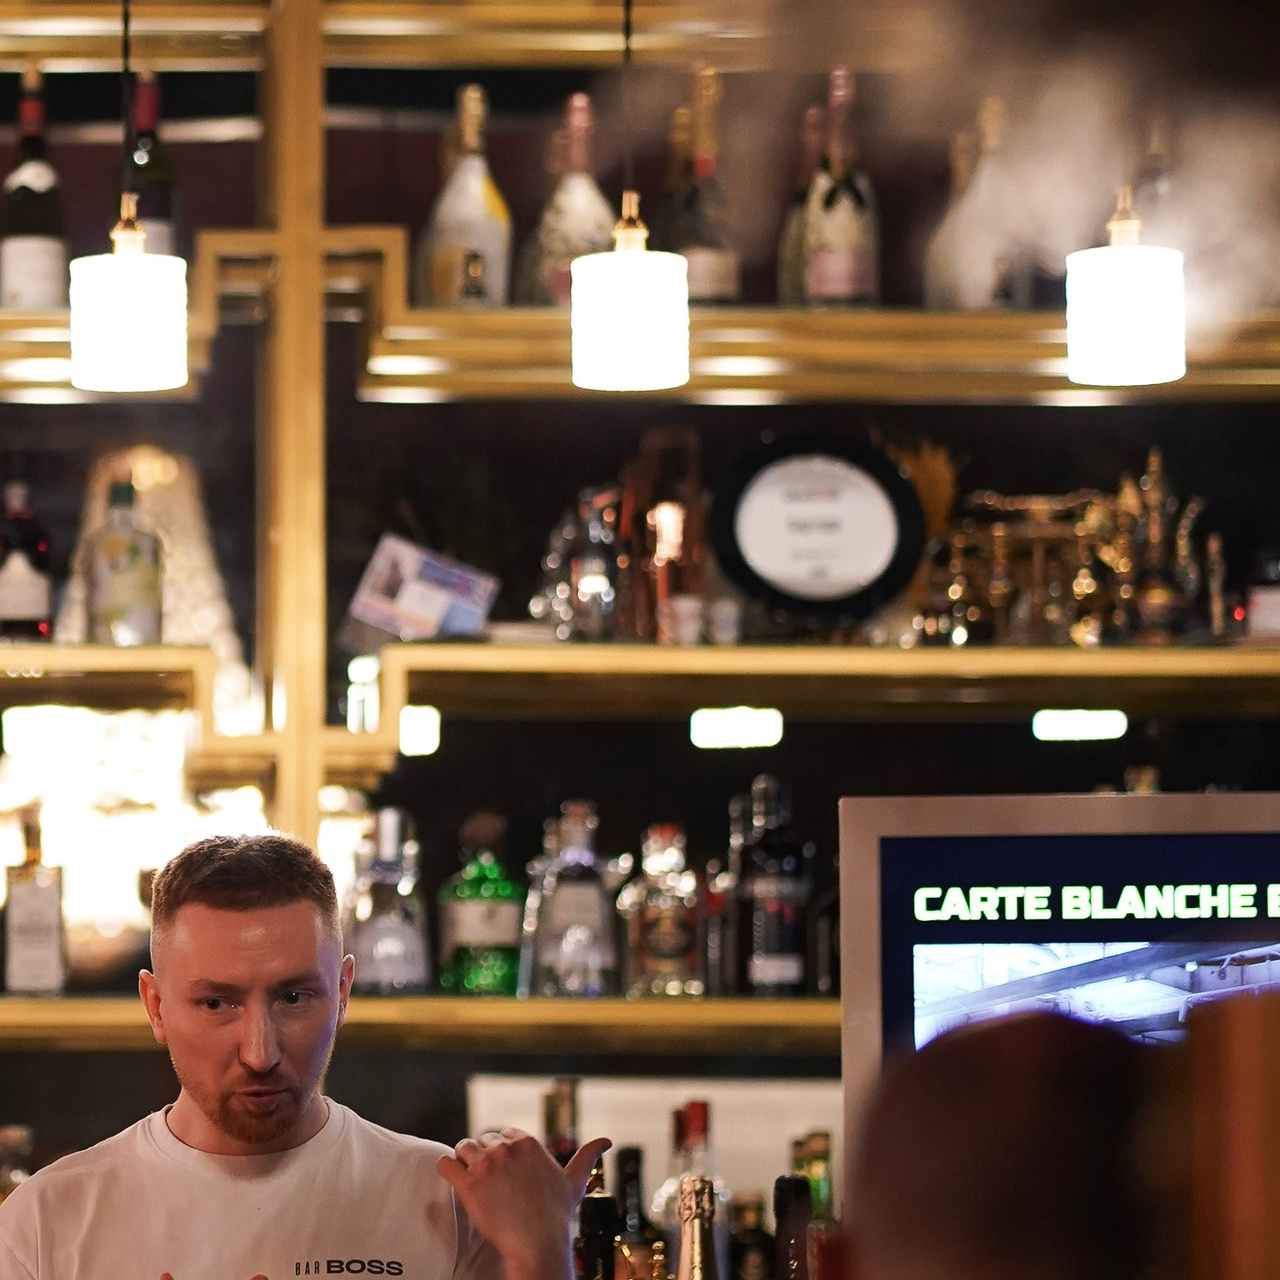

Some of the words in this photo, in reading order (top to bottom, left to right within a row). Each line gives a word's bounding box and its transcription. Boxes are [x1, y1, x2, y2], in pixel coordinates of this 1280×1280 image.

[913, 886, 1052, 921] CARTE
[1061, 884, 1258, 920] BLANCHE
[295, 1260, 321, 1276] BAR
[326, 1259, 404, 1276] BOSS
